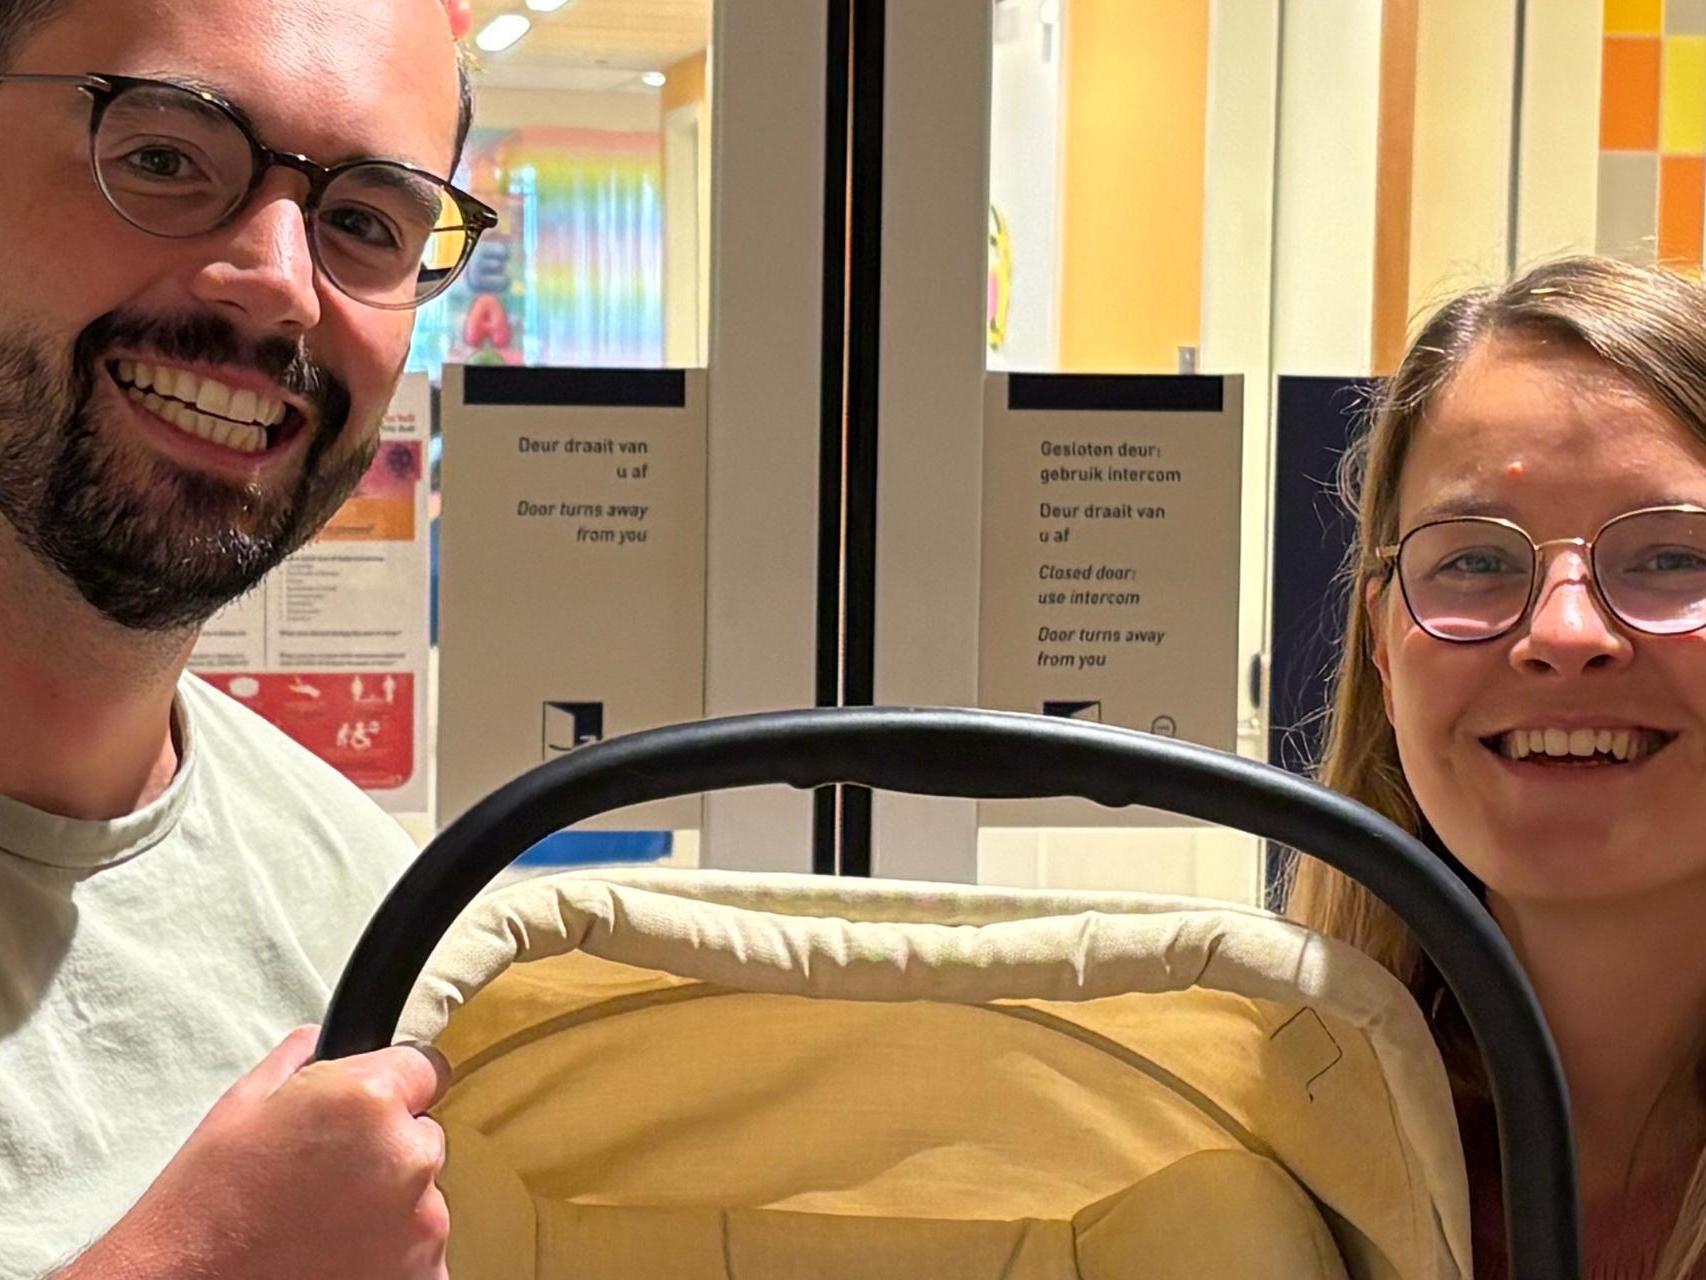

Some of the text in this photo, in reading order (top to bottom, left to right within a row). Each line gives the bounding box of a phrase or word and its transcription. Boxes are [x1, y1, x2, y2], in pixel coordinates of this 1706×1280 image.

[518, 437, 648, 454] Deur draait van
[1041, 441, 1113, 457] Gesloten
[616, 463, 648, 478] u af
[1040, 466, 1181, 484] gebruik intercom
[517, 500, 649, 521] Door turns away
[1039, 502, 1165, 519] Deur draait van
[576, 526, 648, 545] from you
[1039, 527, 1070, 543] u af
[1039, 564, 1093, 580] Closed
[1038, 589, 1140, 605] use intercom
[1038, 626, 1165, 646] Door turns away
[1037, 651, 1106, 670] from you
